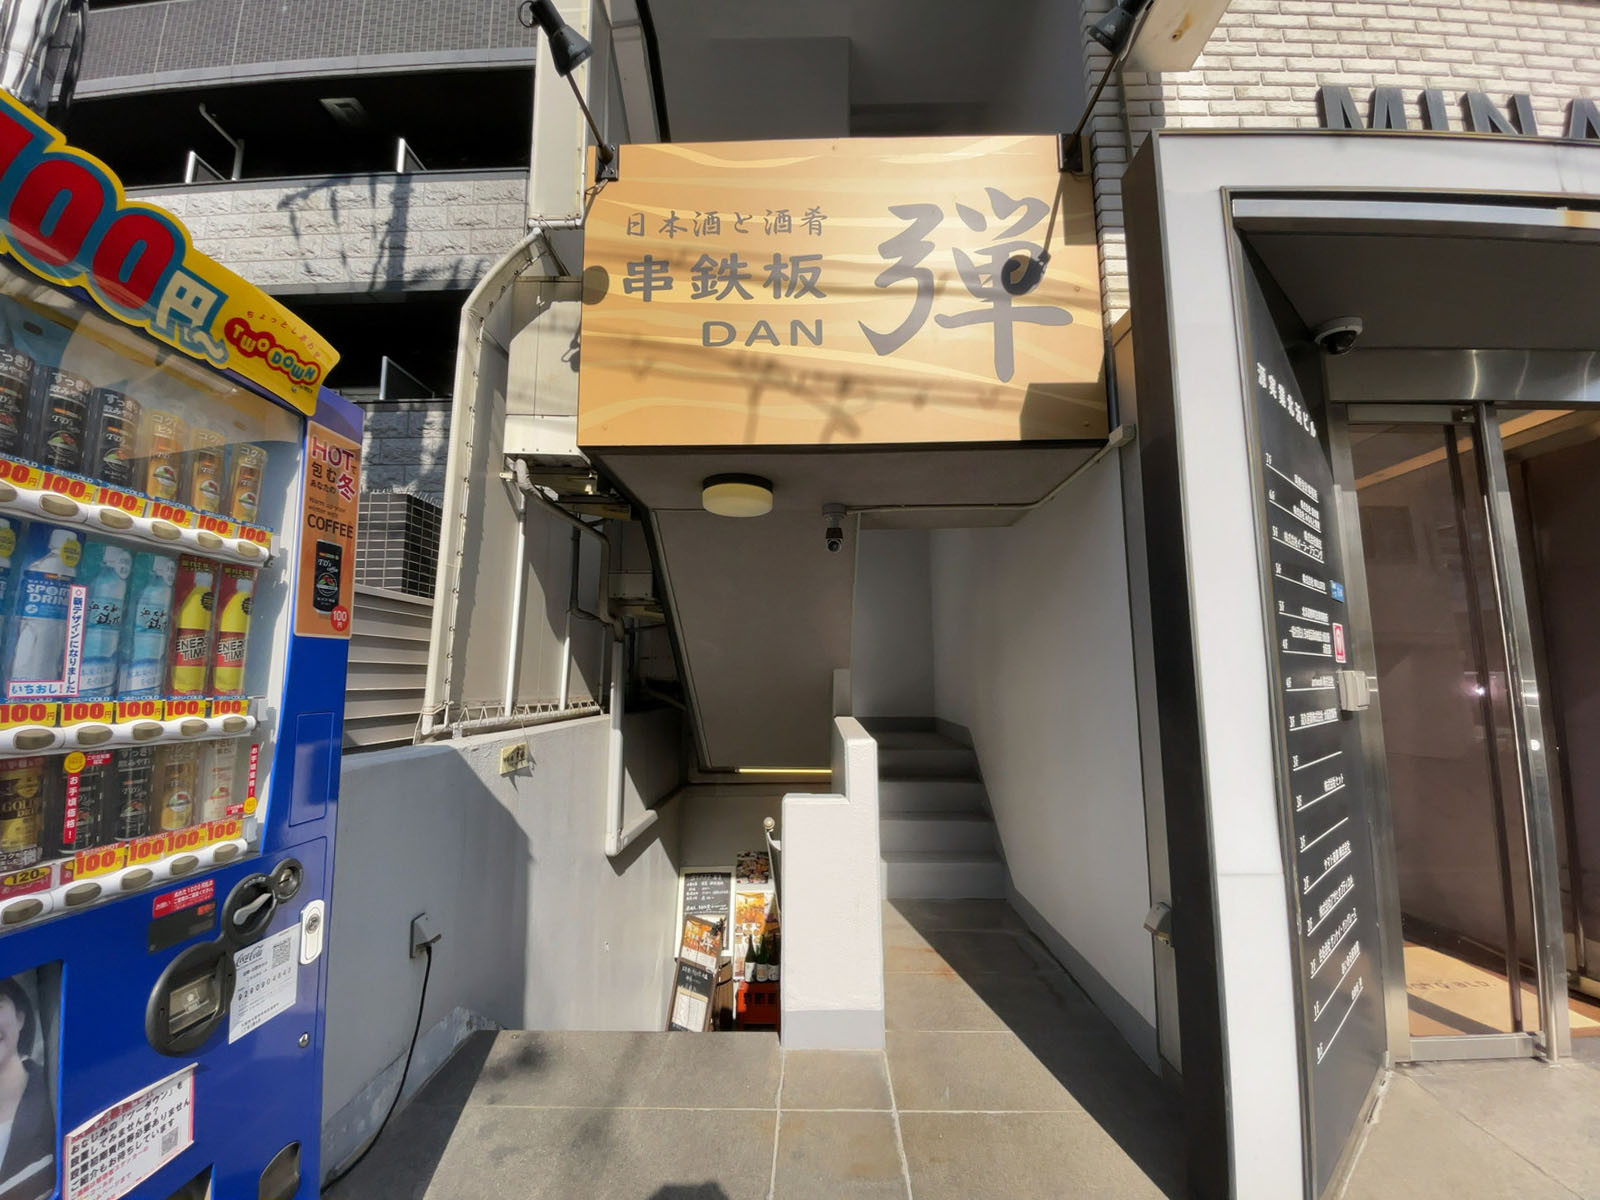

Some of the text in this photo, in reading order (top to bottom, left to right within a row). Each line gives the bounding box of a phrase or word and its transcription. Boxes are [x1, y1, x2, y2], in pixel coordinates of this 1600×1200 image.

[1317, 85, 1600, 138] MIN
[626, 205, 828, 239] 日本酒と酒肴
[622, 252, 827, 302] 串鉄板
[858, 187, 1073, 383] 弾
[702, 319, 824, 347] DAN
[233, 324, 316, 380] TWO DOWN
[312, 436, 354, 470] HOT
[312, 462, 336, 483] 包む
[337, 474, 355, 501] 冬
[307, 513, 353, 538] COFFEE
[333, 610, 347, 622] 100
[63, 703, 111, 721] 100円
